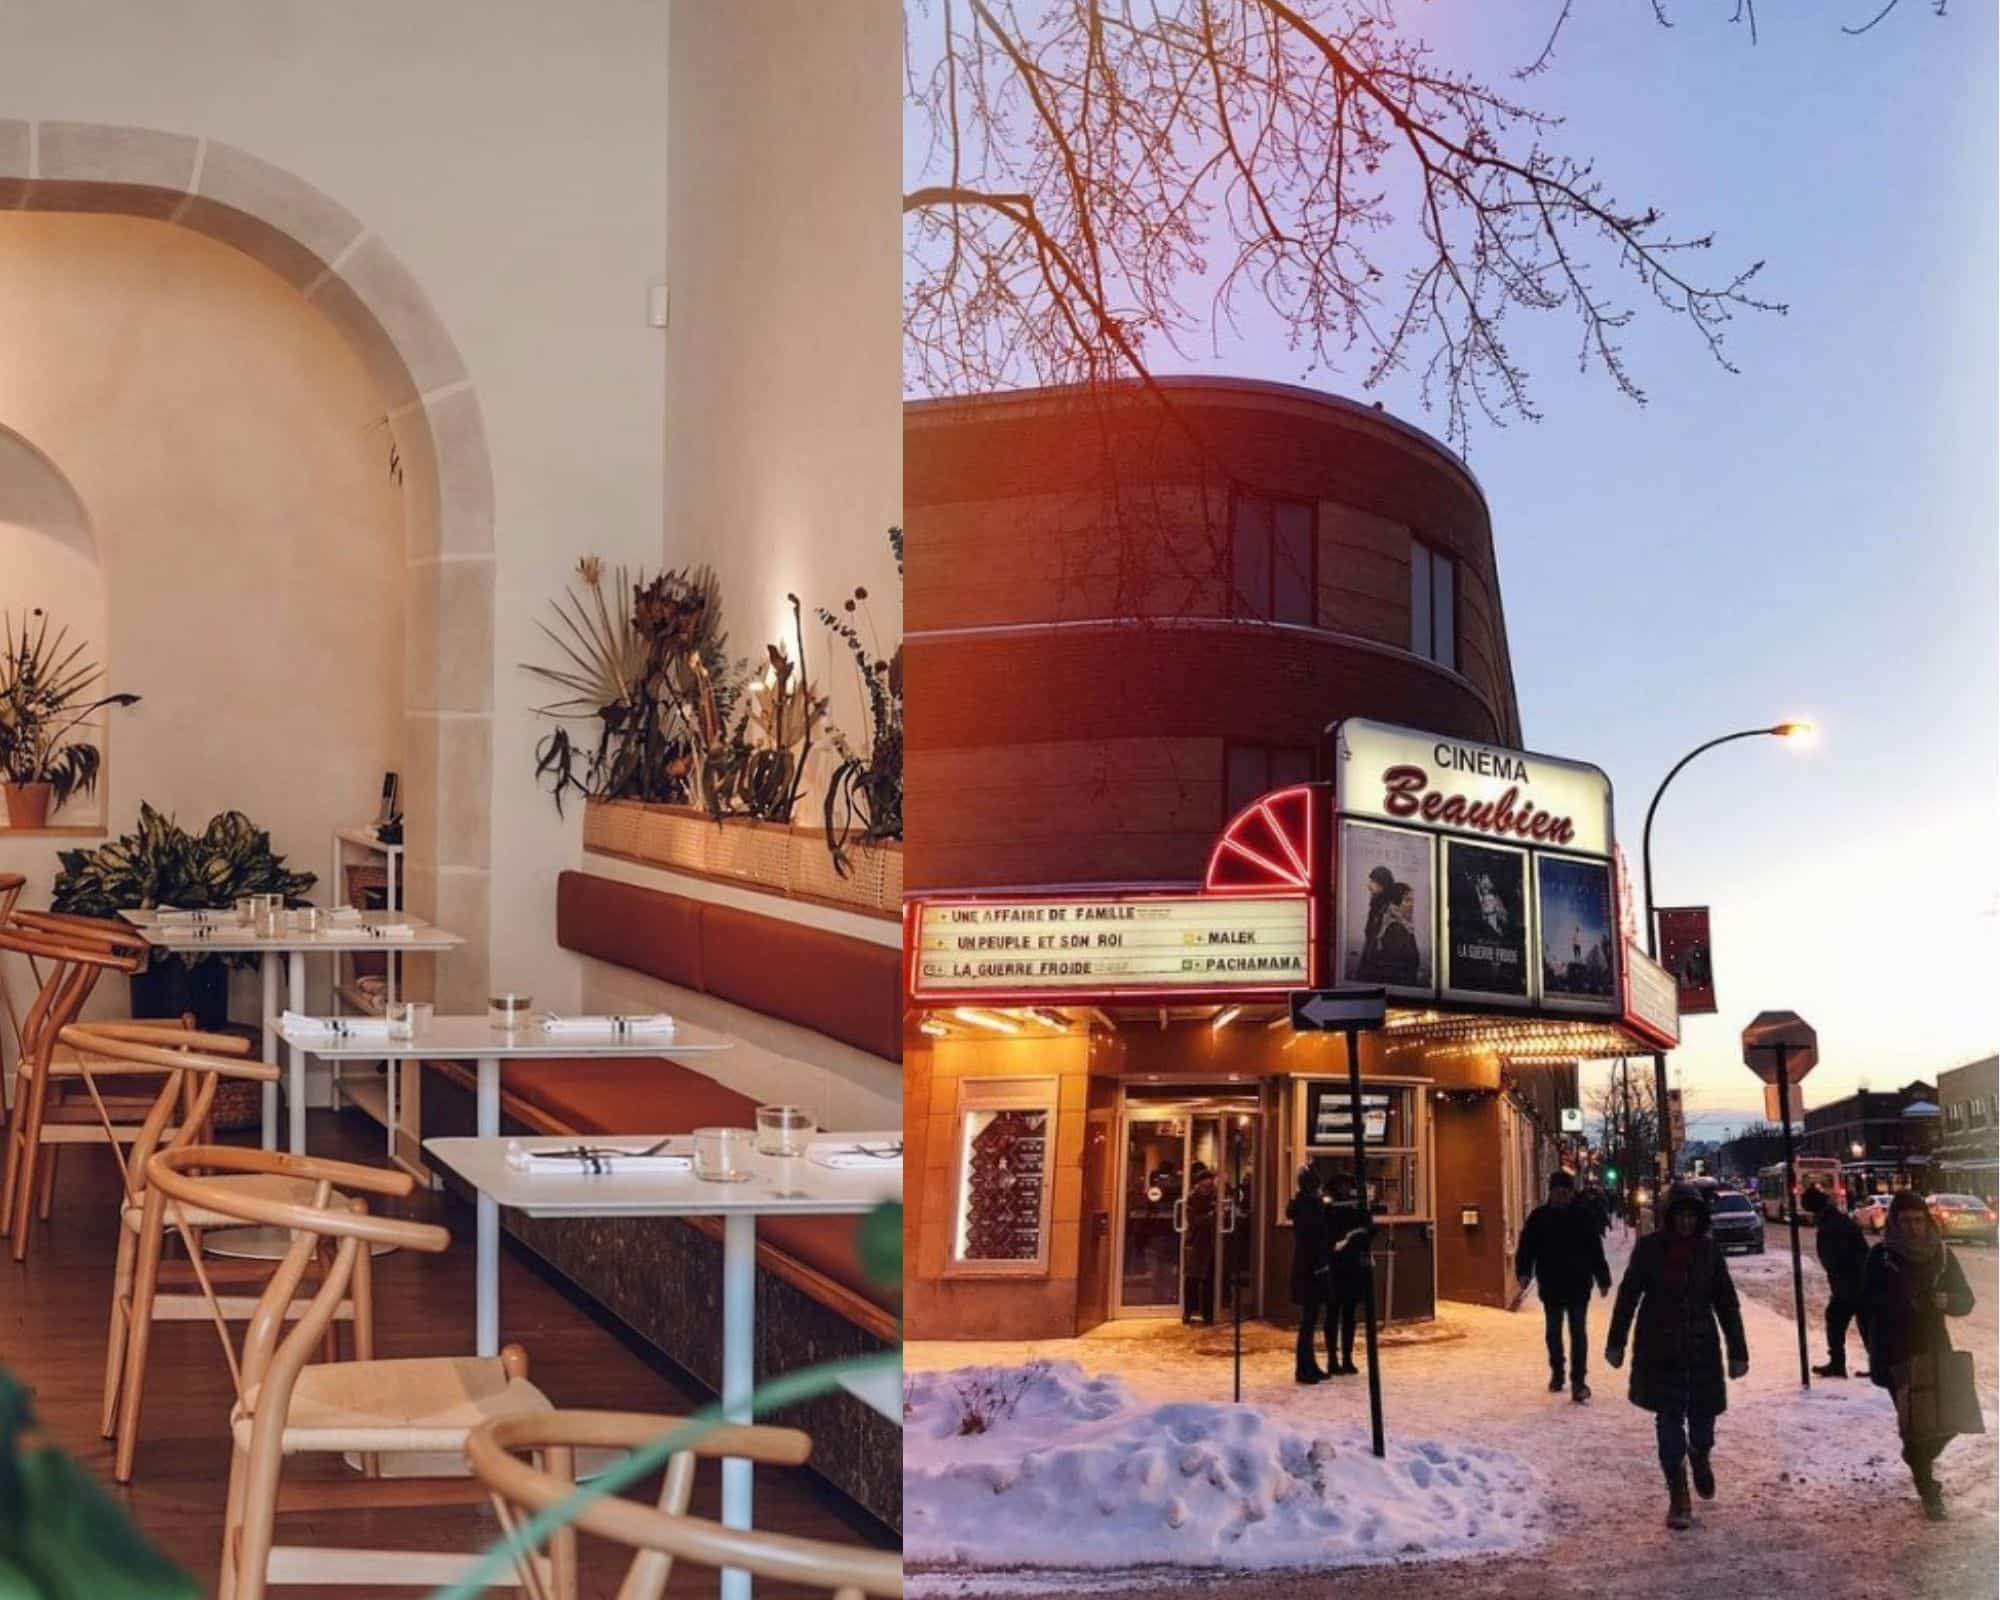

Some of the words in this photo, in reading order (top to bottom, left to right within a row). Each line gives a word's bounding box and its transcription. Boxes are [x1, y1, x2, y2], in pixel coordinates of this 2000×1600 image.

[1433, 743, 1529, 785] CINÉMA
[1383, 764, 1575, 845] Beaubien
[951, 909, 978, 922] UNE
[982, 909, 1045, 922] AFFAIRE
[1048, 908, 1068, 921] DE
[1075, 906, 1135, 920] FAMILLE
[957, 935, 976, 950] UN
[978, 935, 1031, 950] PEUPLE
[1038, 935, 1055, 949] ET
[1060, 935, 1089, 948] SON
[1097, 933, 1123, 947] ROI
[1208, 931, 1256, 945] MALEK
[953, 963, 973, 977] LA
[978, 962, 1033, 977] GUERRE
[1039, 961, 1092, 976] FROIDE
[1206, 956, 1301, 971] PACHAMAMA
